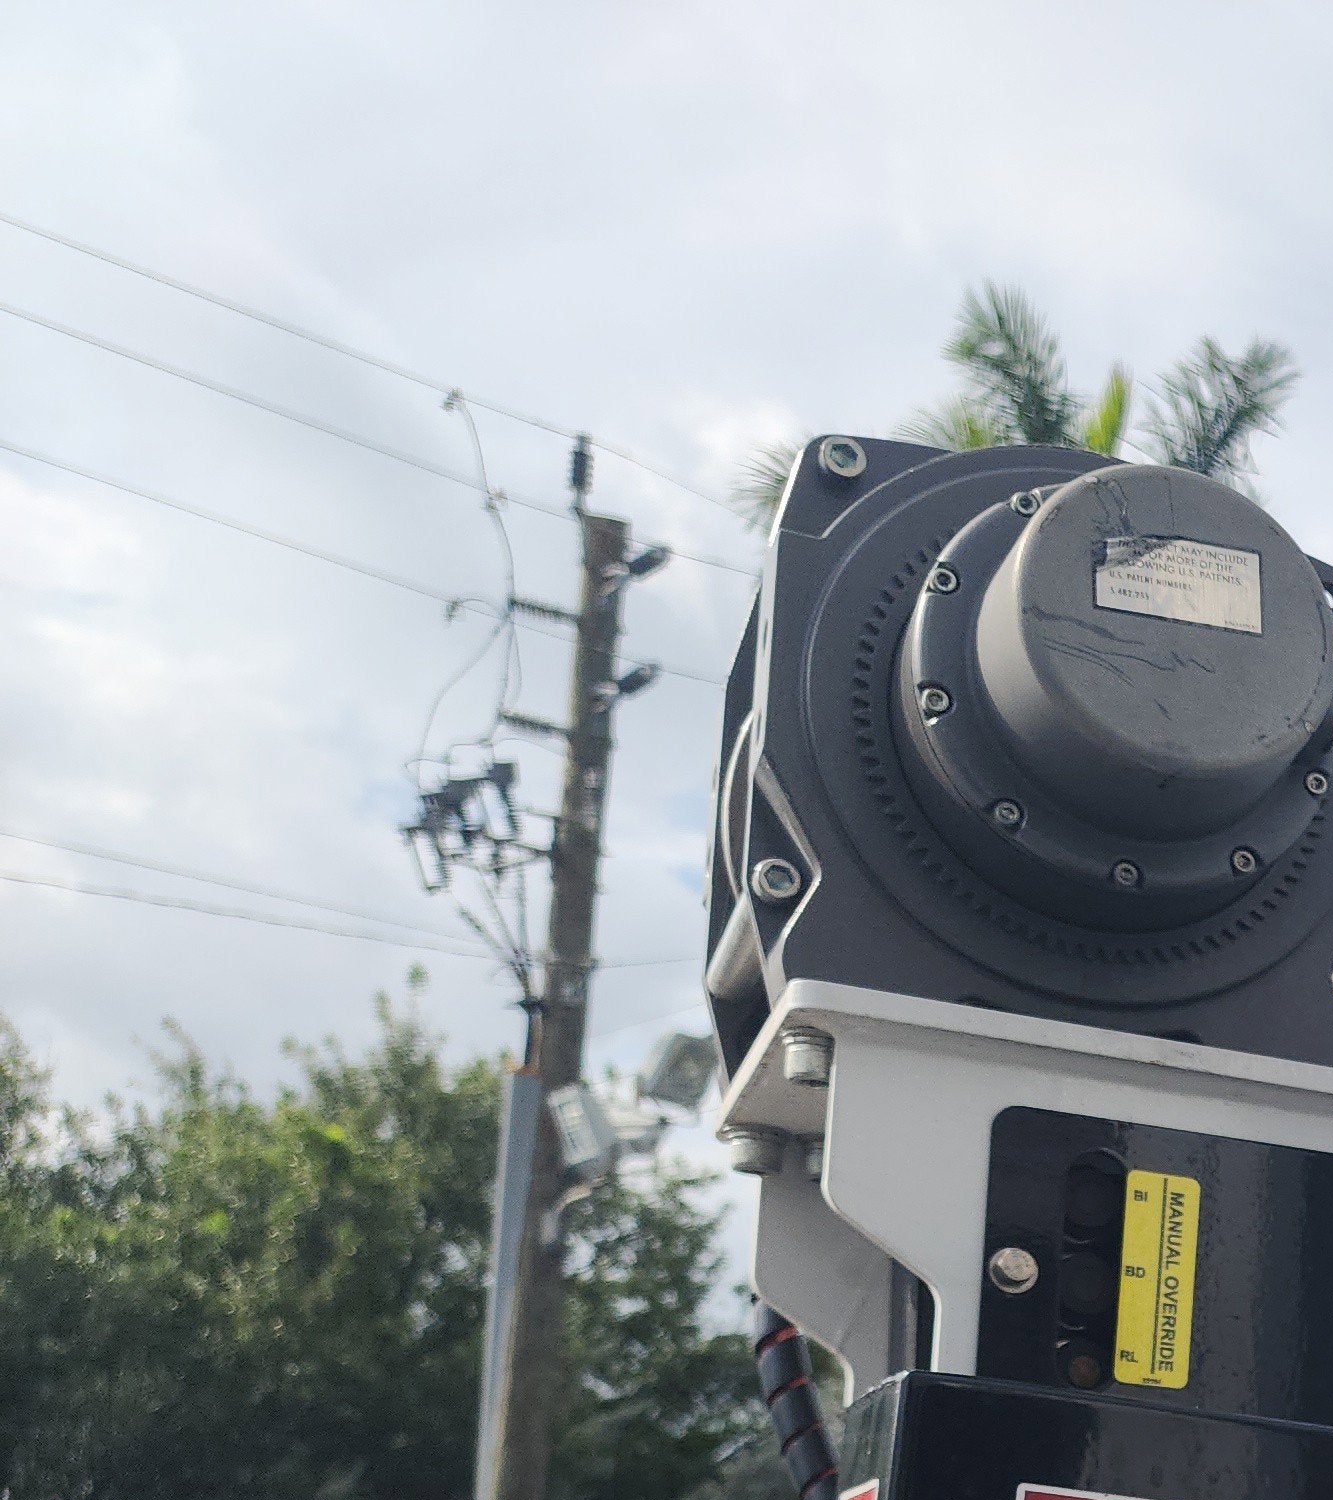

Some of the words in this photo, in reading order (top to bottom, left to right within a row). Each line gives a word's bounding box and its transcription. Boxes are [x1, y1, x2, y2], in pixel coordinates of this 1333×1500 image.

[1166, 555, 1197, 567] MORE
[1215, 563, 1232, 573] THE
[1205, 549, 1249, 566] INCLUDE
[1126, 573, 1154, 585] PATENT
[1134, 1190, 1148, 1202] BI
[1165, 1191, 1185, 1270] MANUAL
[1125, 1265, 1146, 1279] BD
[1158, 1274, 1180, 1373] OVERRIDE
[1119, 1349, 1139, 1363] RL
